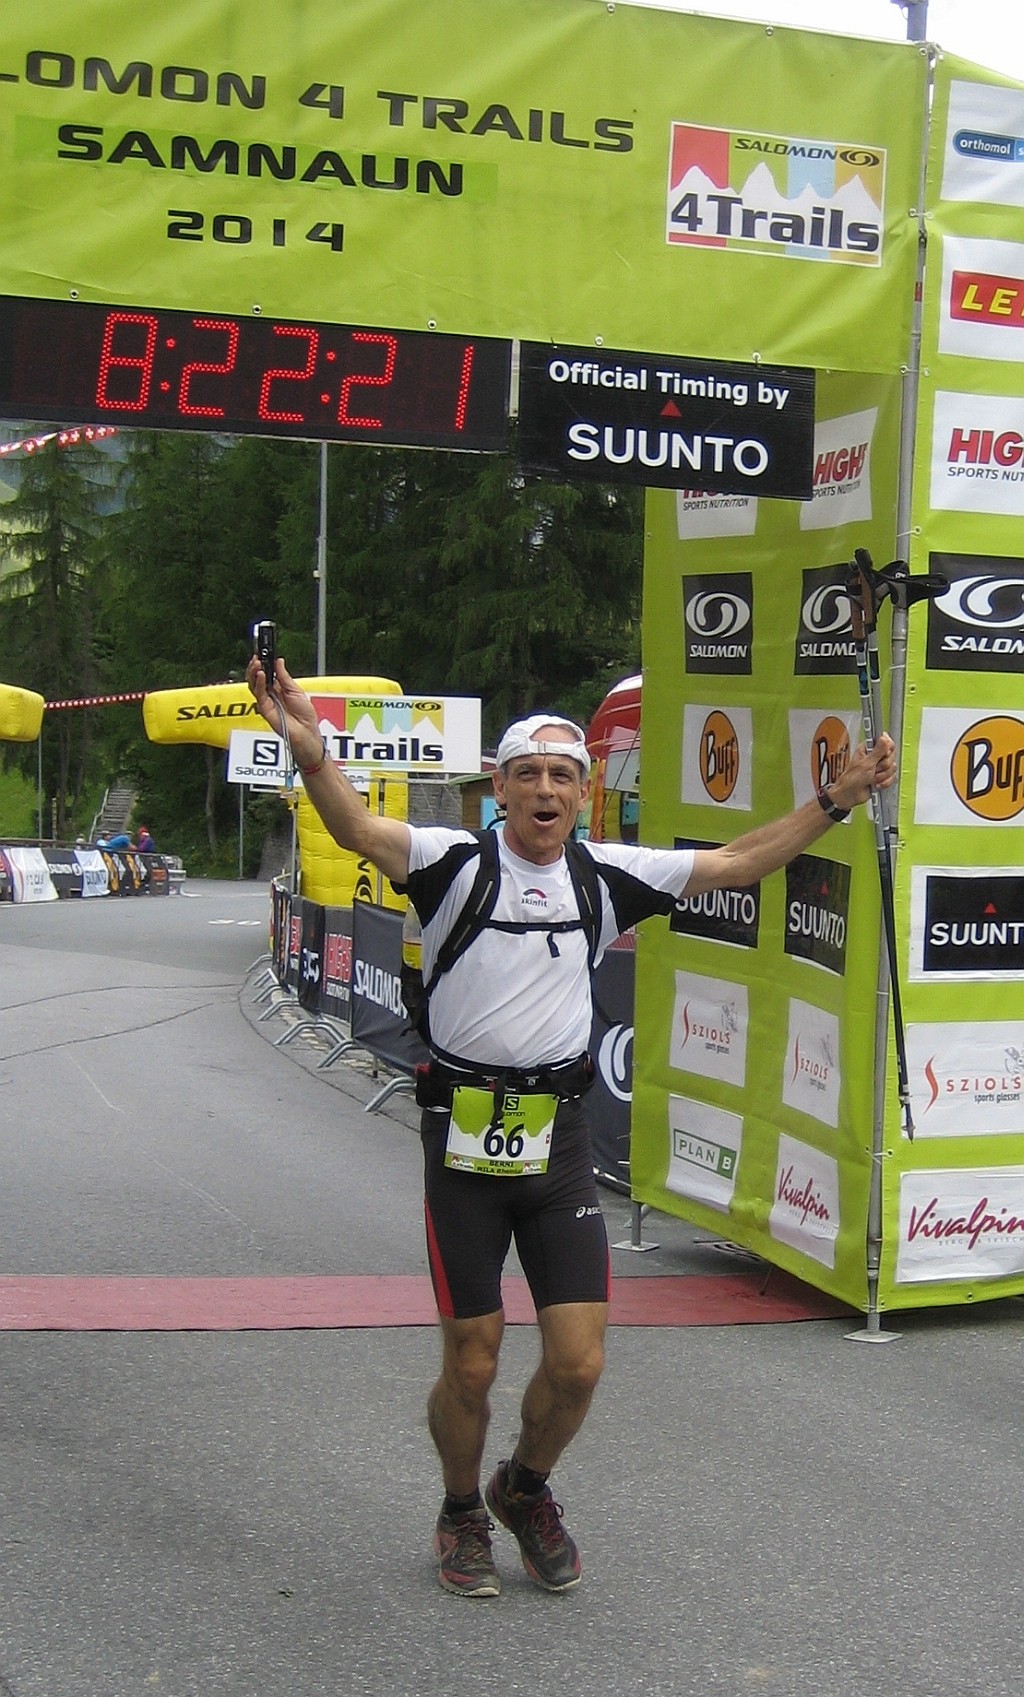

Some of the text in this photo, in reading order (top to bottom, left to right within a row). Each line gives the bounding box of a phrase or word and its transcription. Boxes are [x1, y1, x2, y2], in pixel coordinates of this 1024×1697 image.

[299, 84, 344, 119] 4
[377, 91, 634, 152] TRAILS
[57, 124, 463, 196] SAMNAUN
[734, 137, 838, 160] SALOMON
[960, 139, 1011, 154] orthomol
[167, 209, 344, 252] 2014
[670, 193, 880, 252] 4Trails
[961, 284, 1024, 317] LE
[549, 360, 789, 409] Official Timing by
[567, 424, 768, 477] SUUNTO
[947, 428, 1024, 468] HIG
[947, 466, 999, 480] SPORTS
[683, 498, 749, 511] SPORTS NUTRITION
[689, 644, 747, 658] SALOMON
[800, 642, 867, 657] SALOMO
[176, 702, 260, 720] SALOM
[349, 700, 413, 709] SALOMON
[320, 735, 443, 762] Trails
[789, 901, 846, 948] SUUNTO
[946, 1077, 1021, 1092] SZIOLS
[974, 1092, 1020, 1104] sports glasses
[484, 1123, 524, 1158] 66
[679, 1138, 732, 1170] PLAN B
[778, 1165, 830, 1226] Vivalpin
